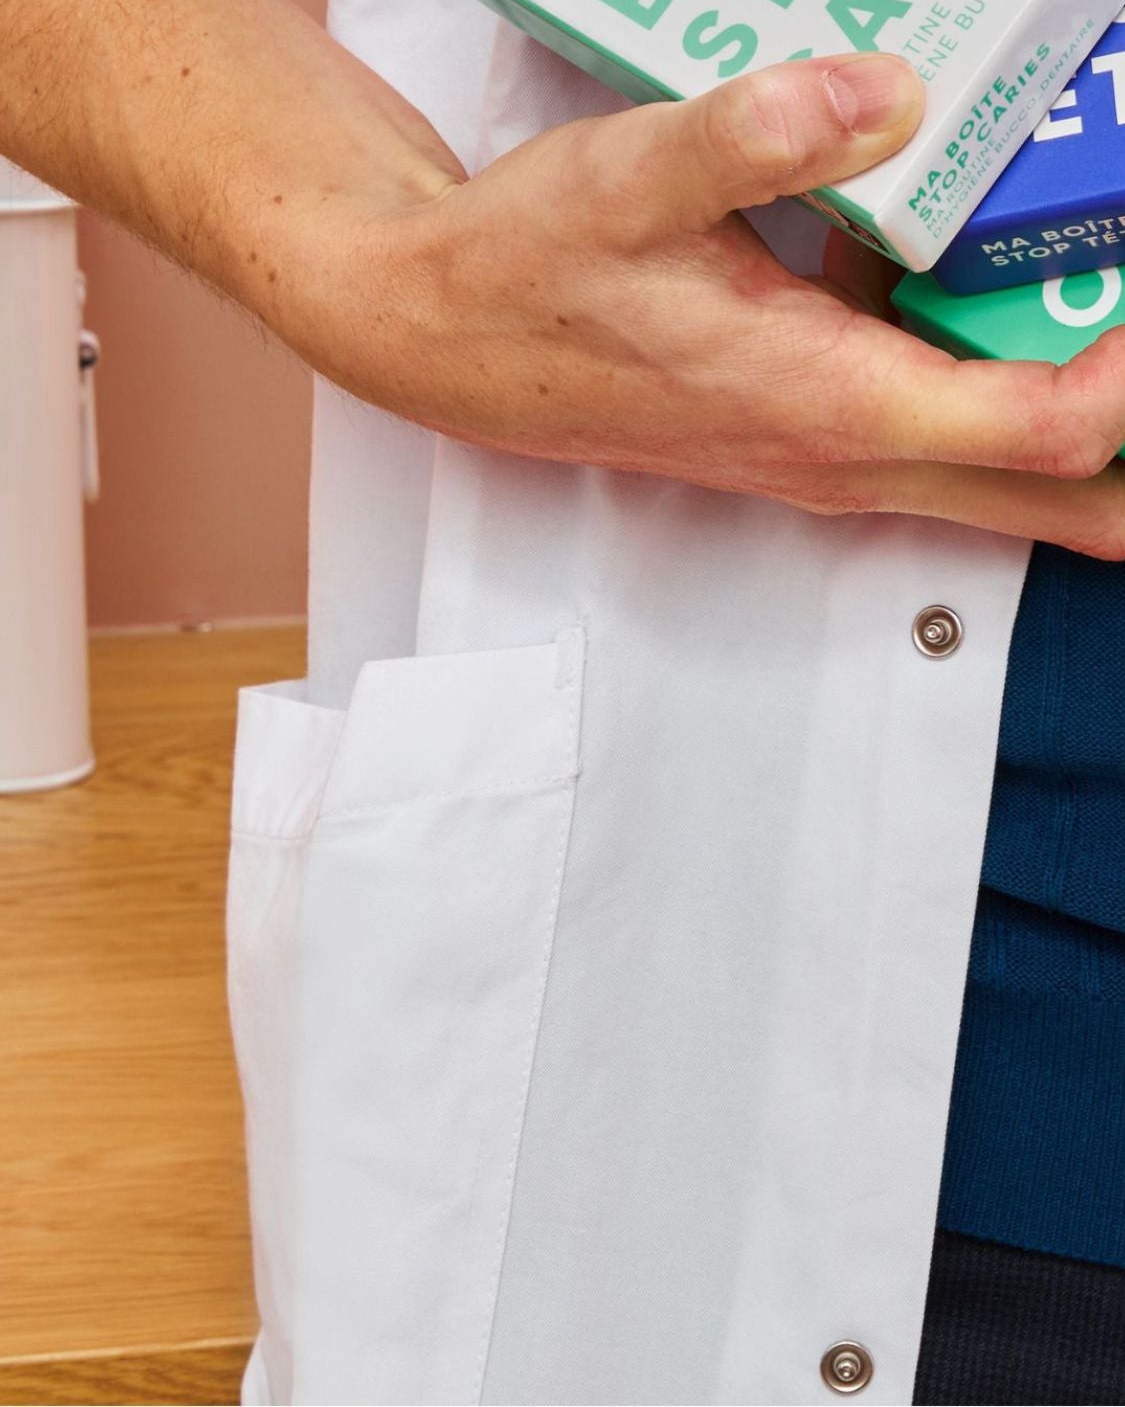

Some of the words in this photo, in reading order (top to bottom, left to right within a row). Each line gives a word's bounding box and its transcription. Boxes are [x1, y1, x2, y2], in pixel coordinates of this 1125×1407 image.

[903, 1, 951, 54] TINE
[907, 169, 942, 211] MA
[944, 75, 1007, 159] BOÎTE
[918, 150, 969, 222] STOP
[977, 42, 1052, 142] CARIES
[946, 140, 997, 204] ROUTINE
[981, 237, 1030, 255] MA
[991, 243, 1070, 266] STOP
